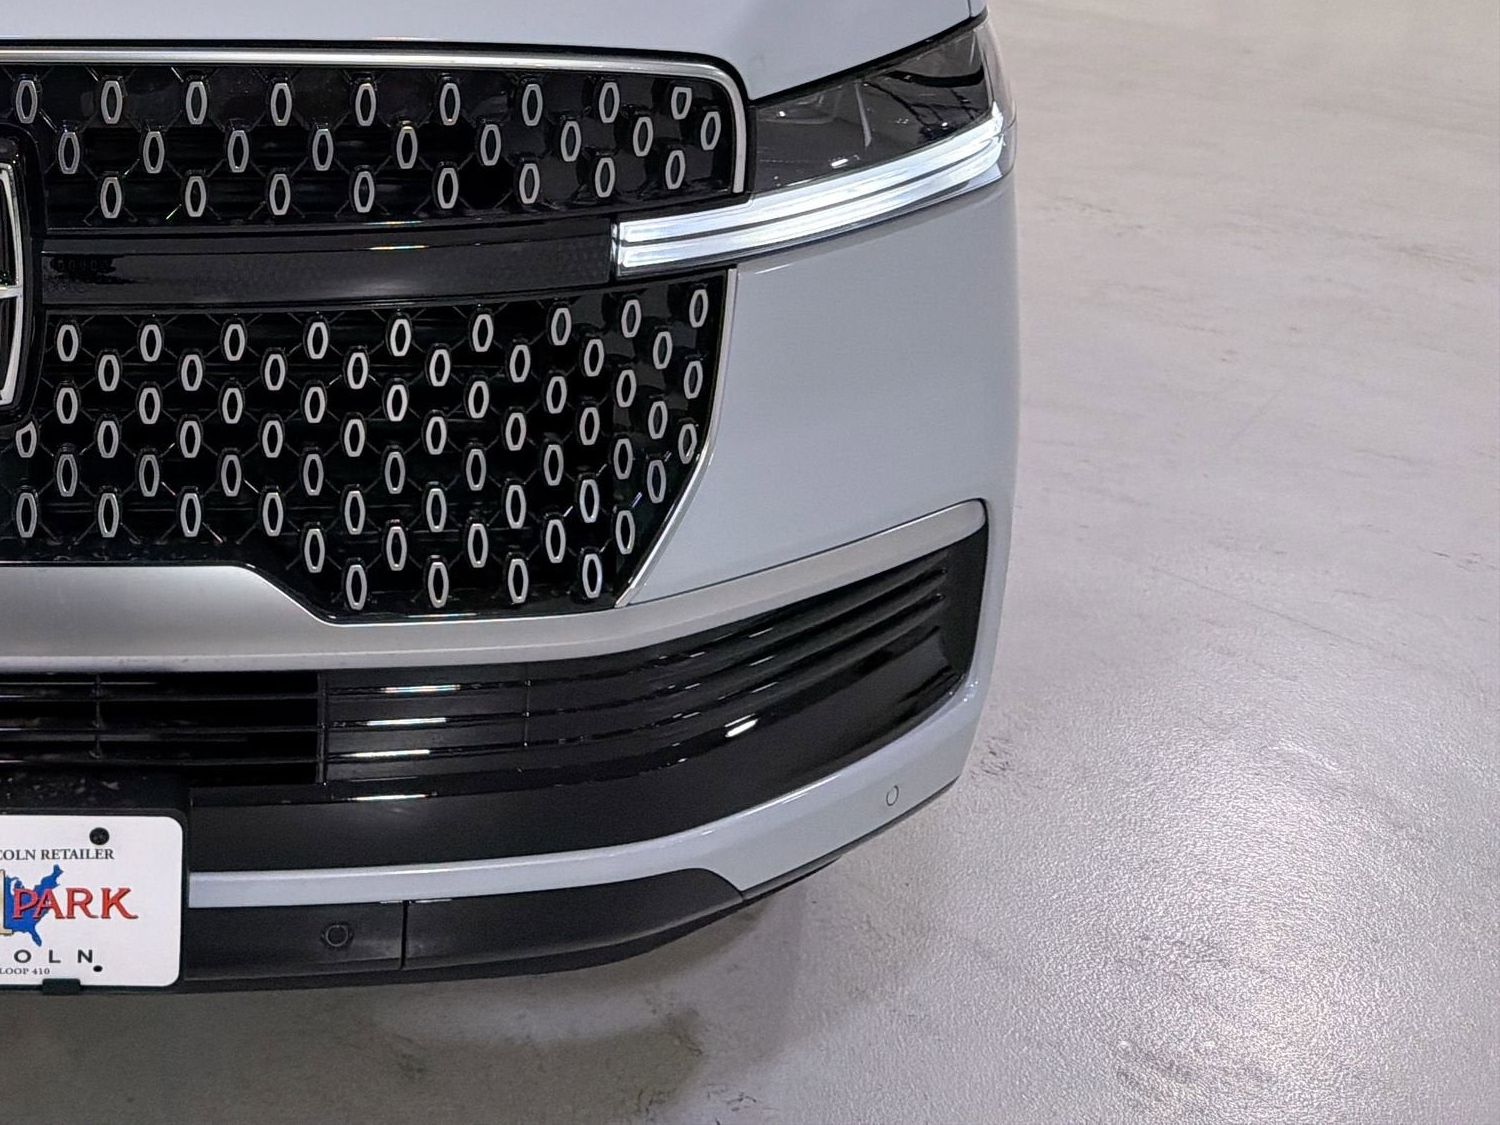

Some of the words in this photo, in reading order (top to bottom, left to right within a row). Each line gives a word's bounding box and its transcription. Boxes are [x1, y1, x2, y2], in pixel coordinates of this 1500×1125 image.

[41, 849, 115, 860] RETAILER
[12, 887, 139, 920] PARK
[31, 966, 51, 976] 410
